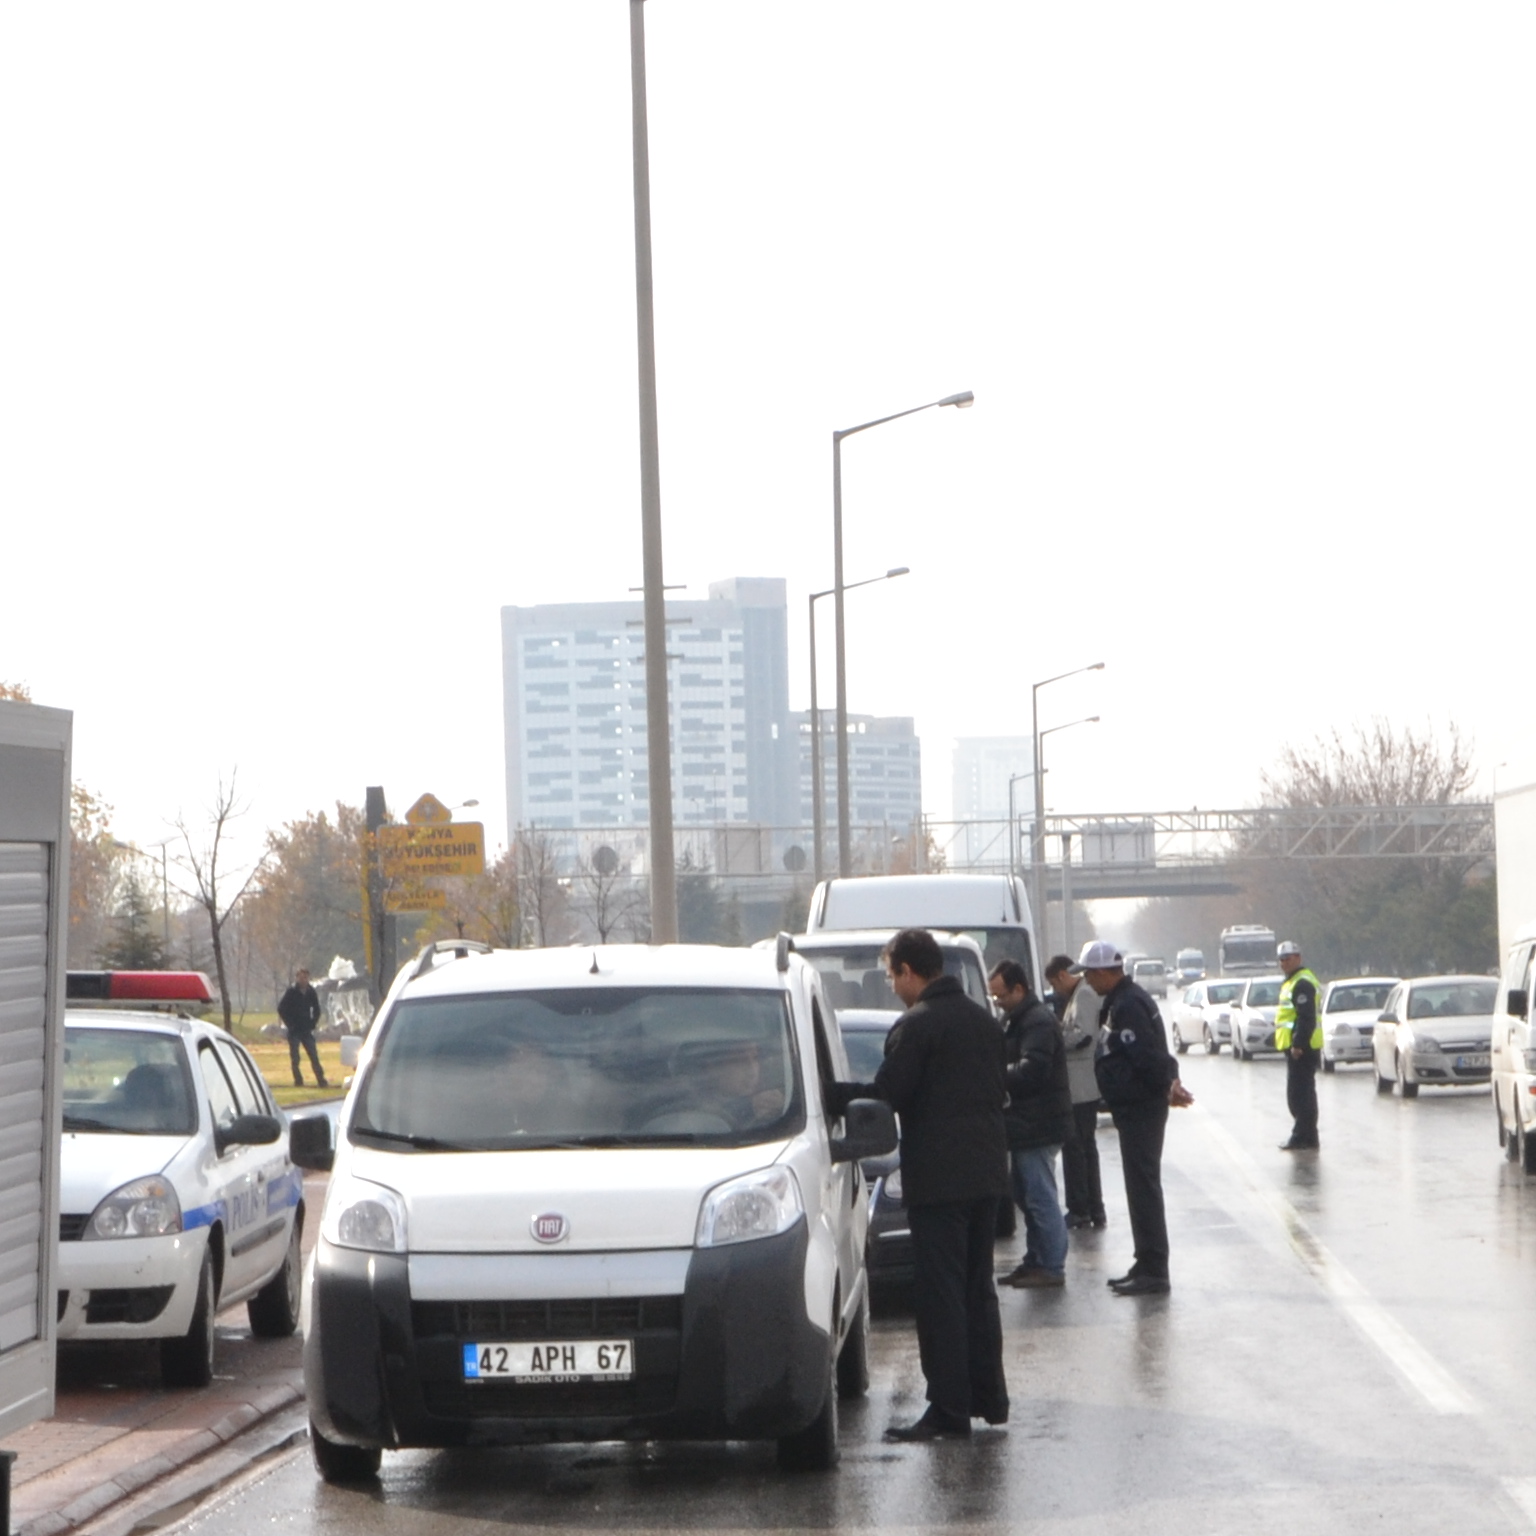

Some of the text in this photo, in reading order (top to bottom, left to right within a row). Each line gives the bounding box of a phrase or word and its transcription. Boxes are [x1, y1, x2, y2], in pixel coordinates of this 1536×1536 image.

[539, 1219, 561, 1234] FIAT
[479, 1347, 509, 1373] 42
[531, 1345, 576, 1372] APH
[597, 1344, 627, 1370] 67
[555, 1373, 580, 1383] OTO
